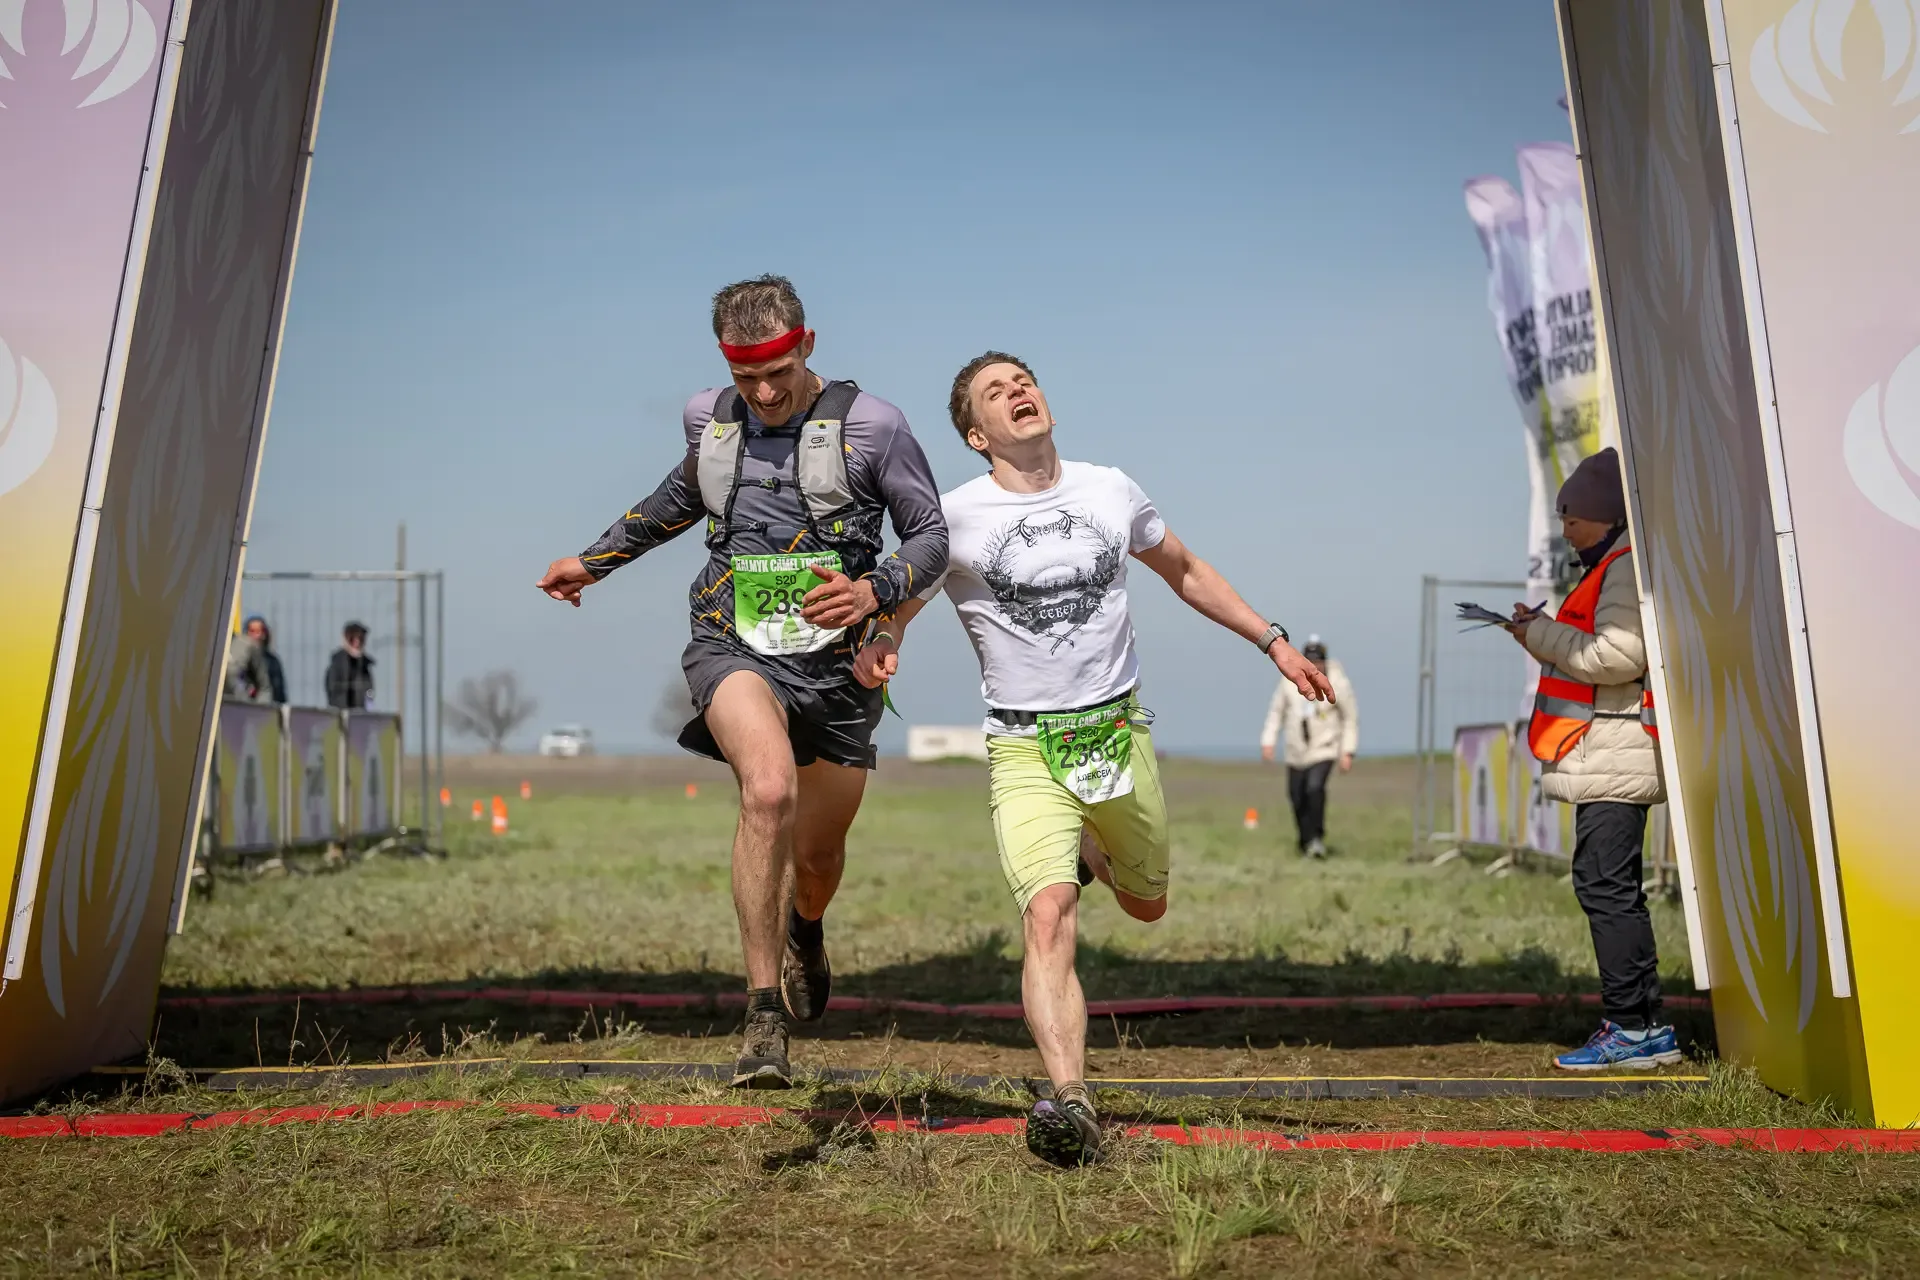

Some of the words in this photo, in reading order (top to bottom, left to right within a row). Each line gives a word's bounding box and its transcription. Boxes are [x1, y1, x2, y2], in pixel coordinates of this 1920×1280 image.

[736, 559, 769, 573] KALMYK
[770, 557, 800, 573] CAMEL
[775, 575, 797, 585] S20
[756, 588, 809, 615] 239
[1080, 728, 1099, 738] S20
[1057, 735, 1118, 769] 2360
